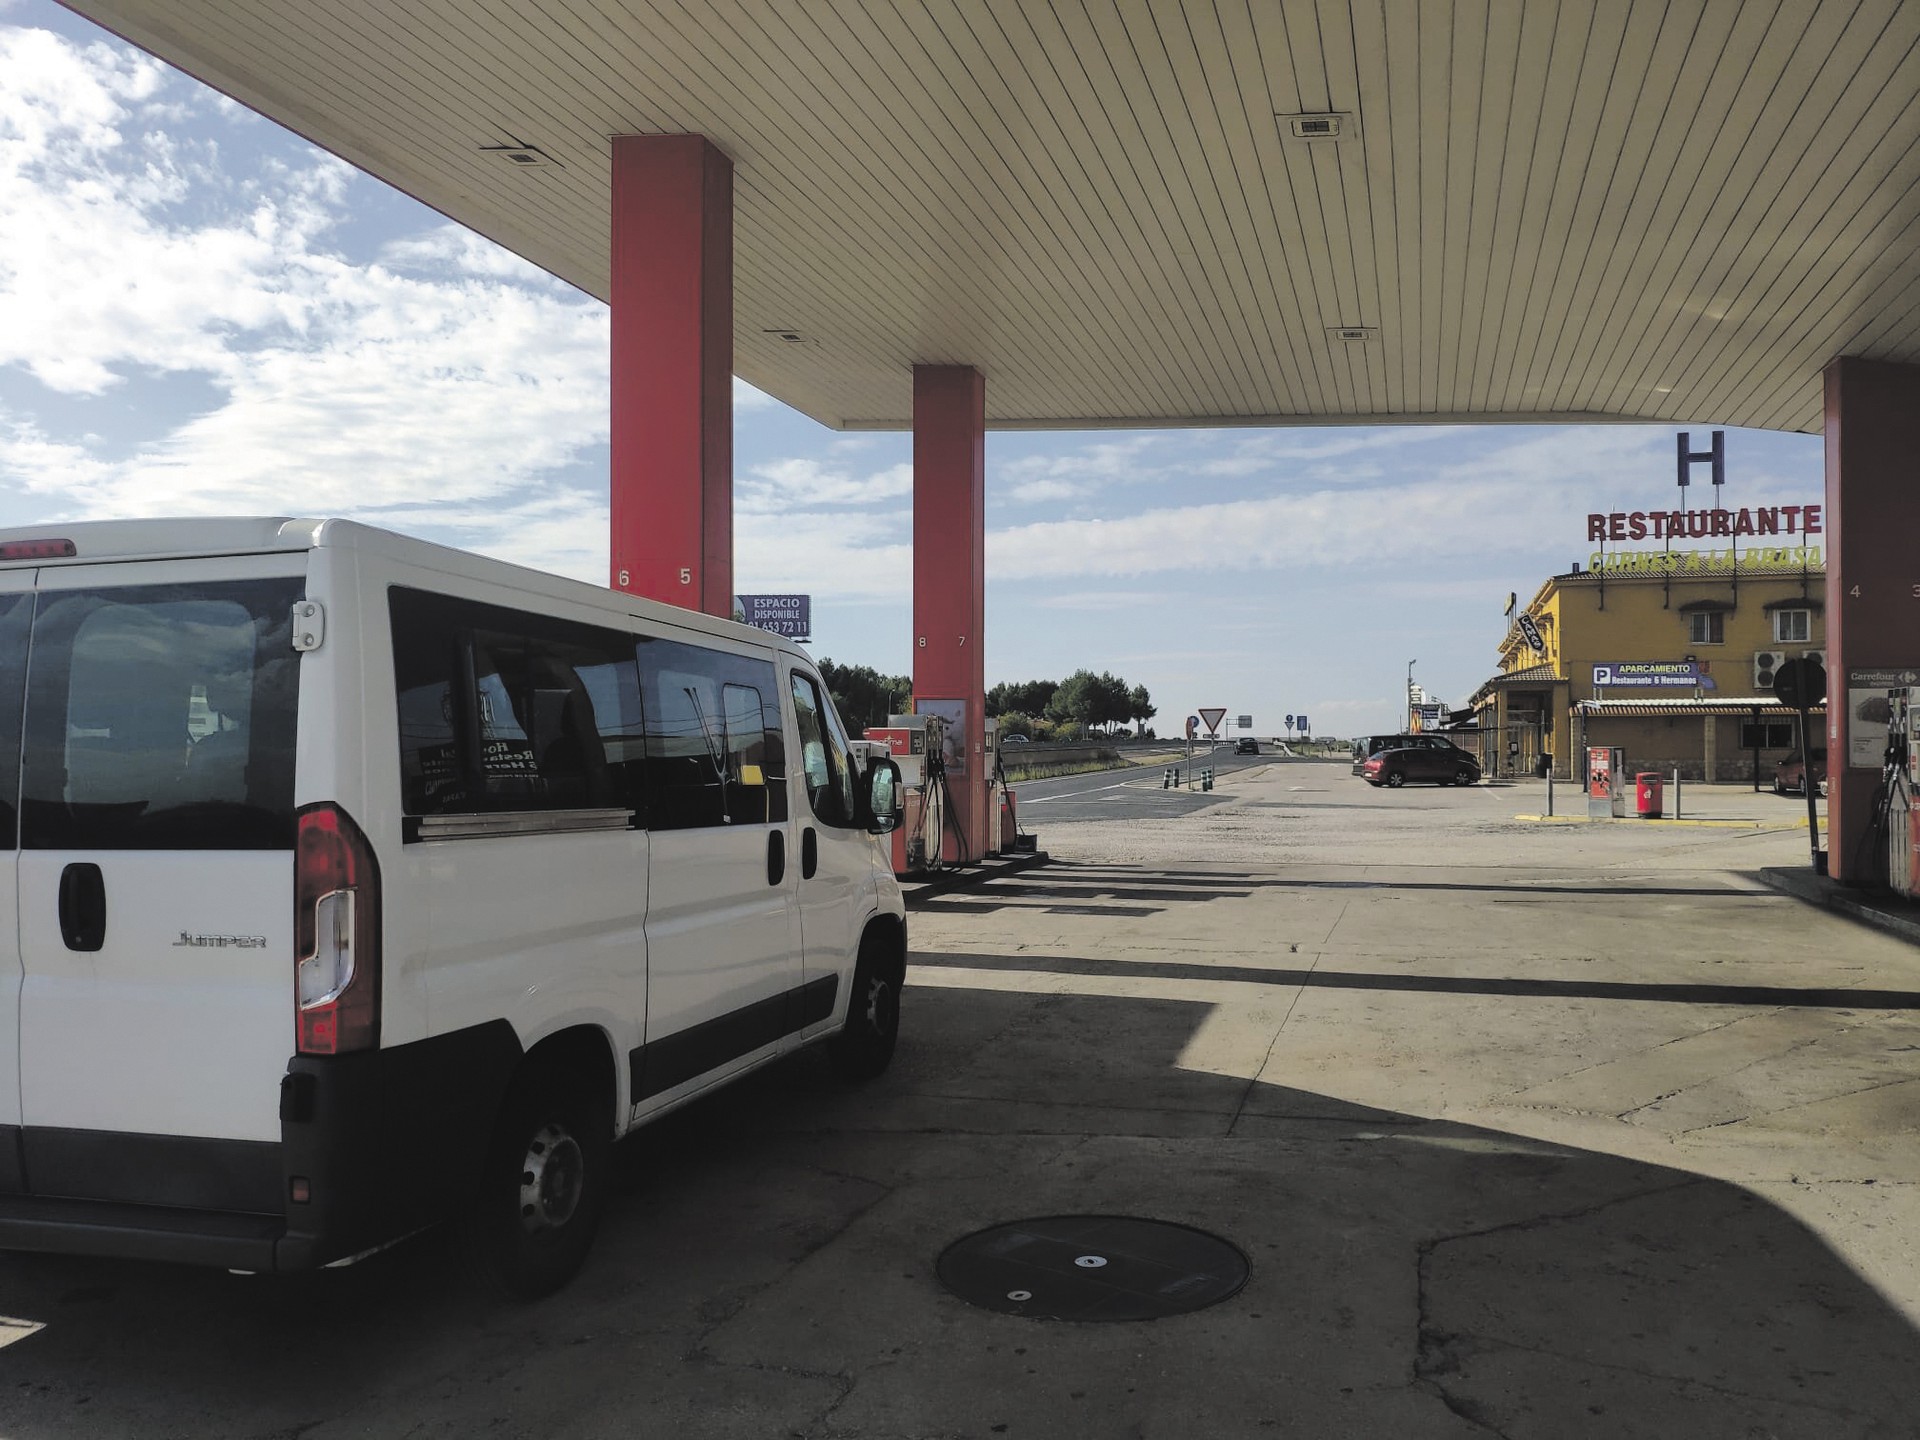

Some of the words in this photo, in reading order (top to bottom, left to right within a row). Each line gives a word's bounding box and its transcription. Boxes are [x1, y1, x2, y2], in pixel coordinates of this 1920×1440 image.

[1677, 430, 1725, 486] H
[1587, 505, 1822, 542] RESTAURANTE
[1588, 550, 1679, 574] CARNES
[1682, 549, 1701, 571] A
[1705, 548, 1735, 571] LA
[619, 570, 630, 586] 6
[680, 568, 691, 584] 5
[1849, 584, 1861, 598] 4
[754, 598, 800, 608] ESPACIO
[754, 610, 800, 619] DISPONIBLE
[762, 621, 780, 633] 653
[782, 621, 794, 633] 72
[797, 621, 807, 633] 11
[918, 636, 926, 647] 8
[958, 636, 966, 647] 7
[1619, 664, 1690, 673] APARCAMIENTO
[1611, 676, 1652, 685] Restaurante
[1661, 675, 1697, 685] Hermanos
[1851, 672, 1896, 681] Carrefour
